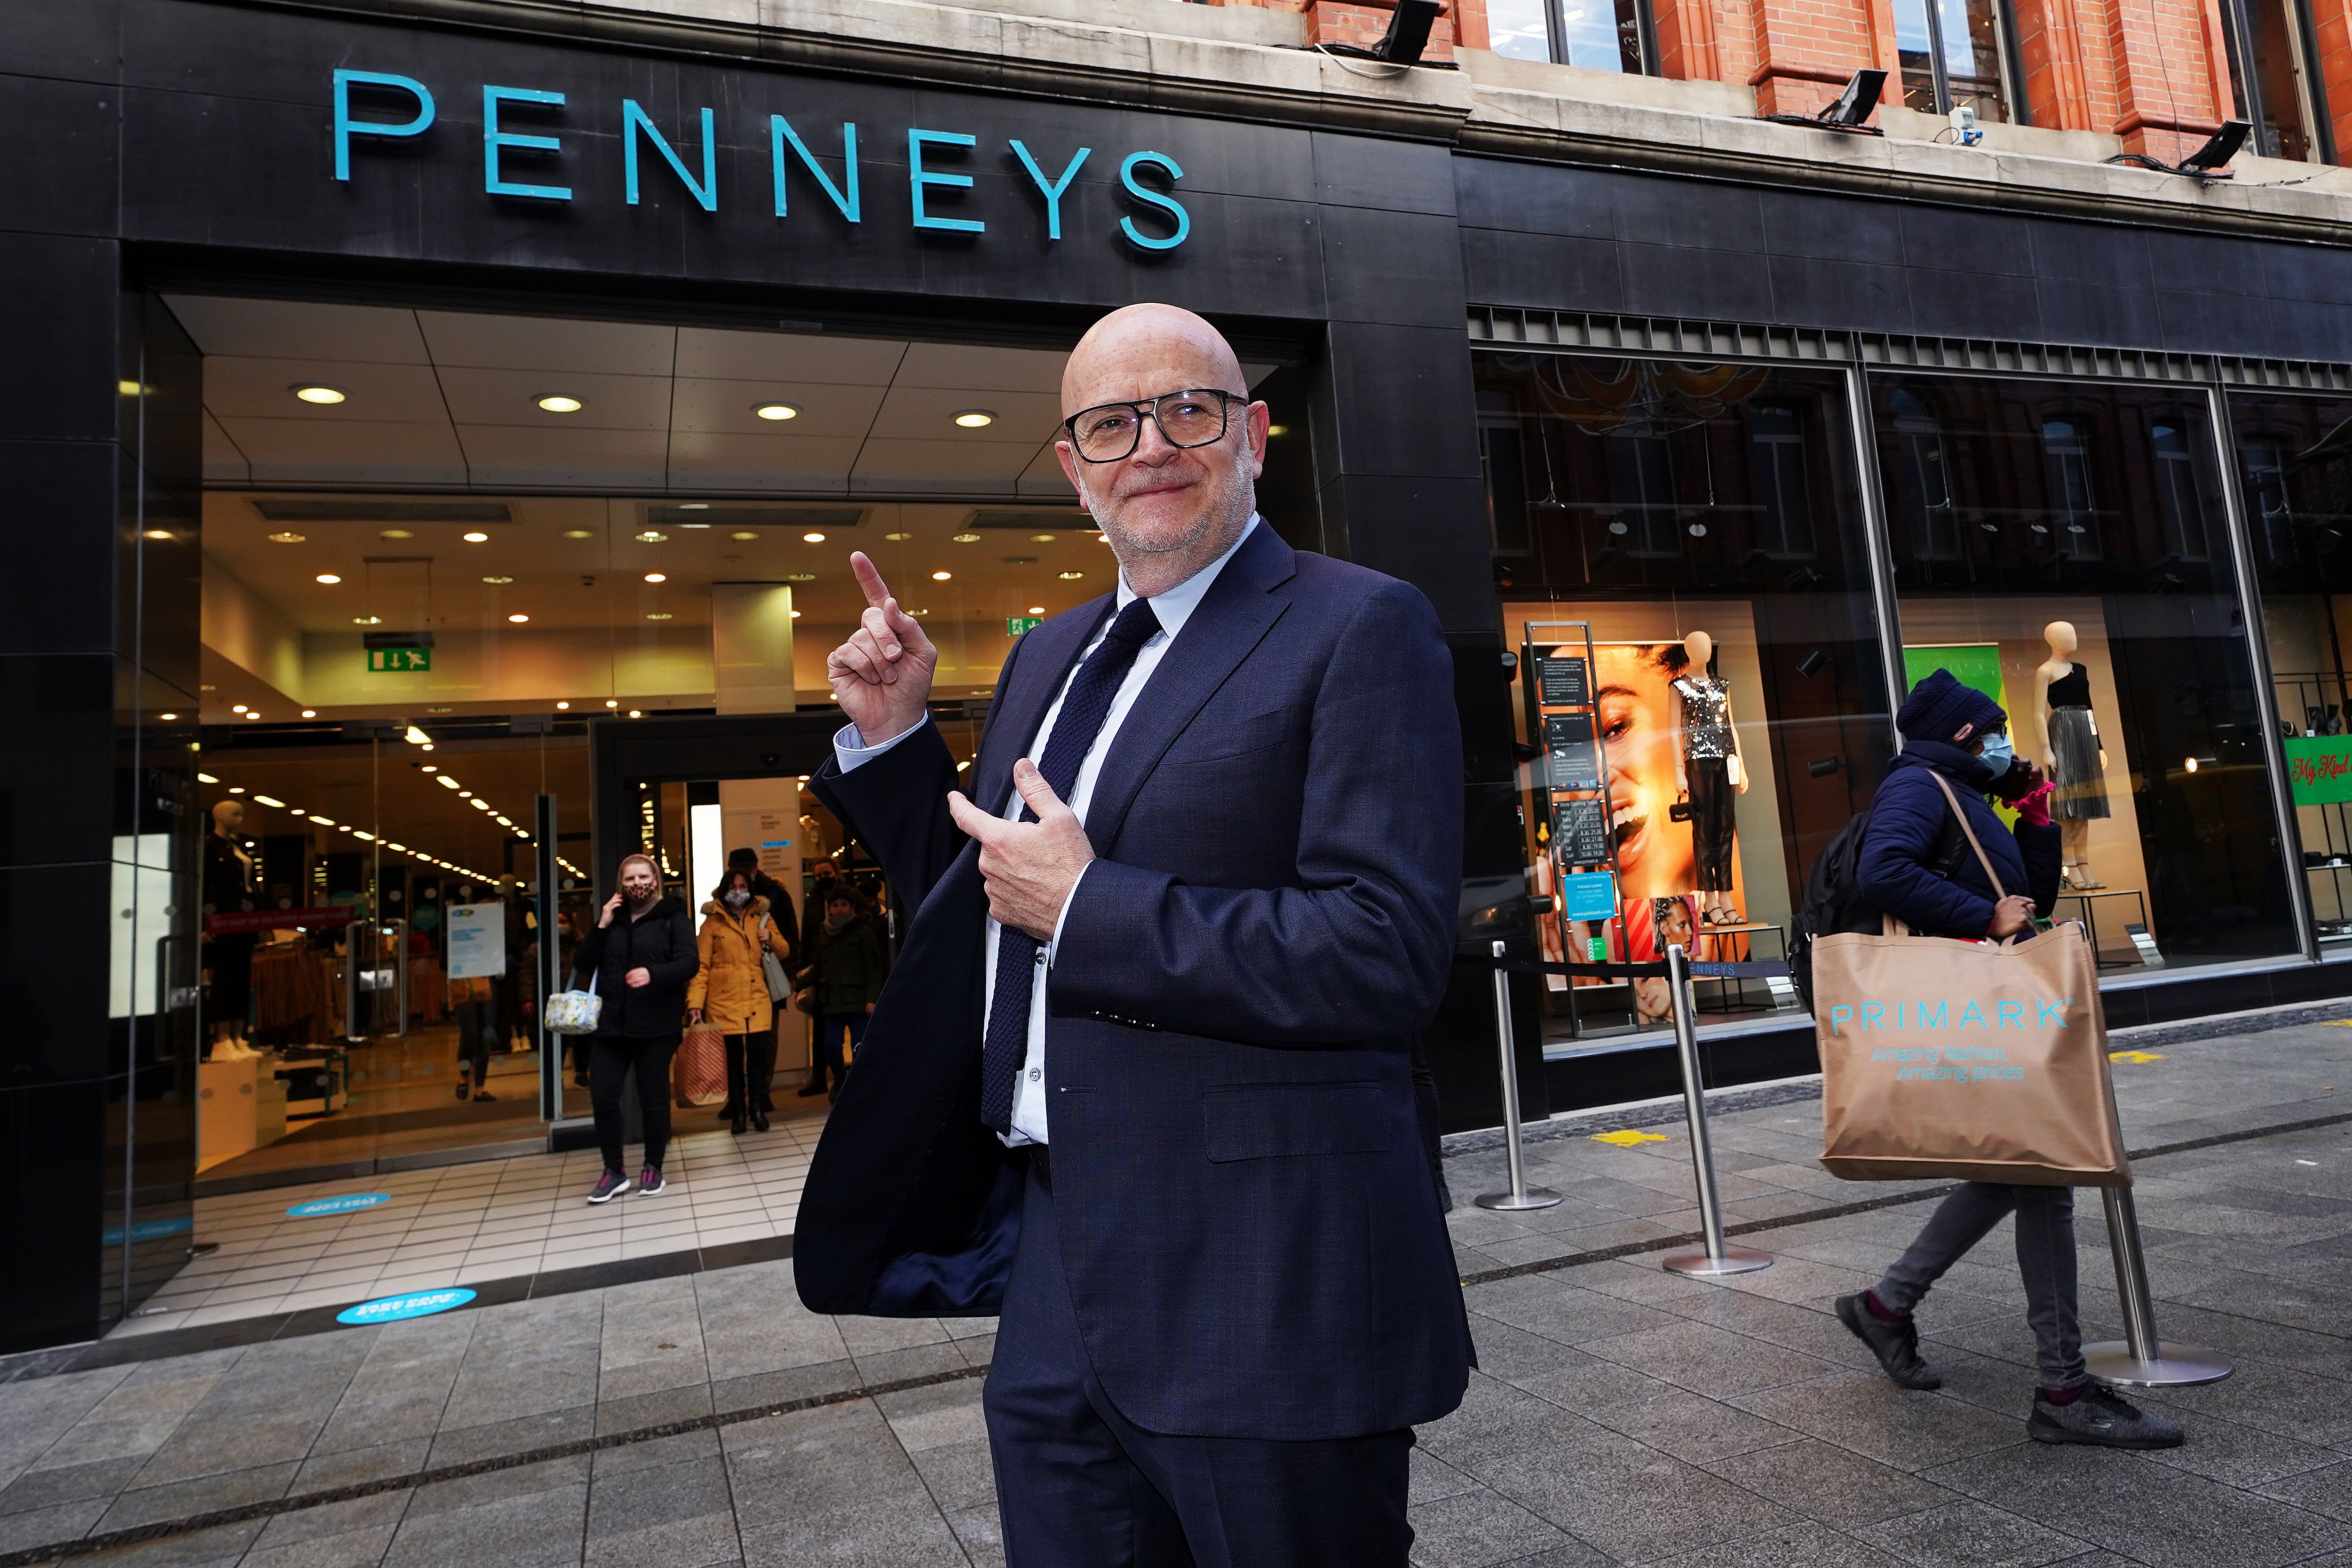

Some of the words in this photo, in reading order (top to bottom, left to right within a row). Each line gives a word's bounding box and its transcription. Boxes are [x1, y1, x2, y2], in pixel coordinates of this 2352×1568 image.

[333, 69, 1190, 249] PENNEYS
[2291, 756, 2316, 786] My
[2318, 753, 2350, 779] Kind
[1690, 962, 1735, 976] ENNEYS
[1832, 999, 2068, 1035] PRIMARK
[1870, 1046, 1940, 1064] Amazing
[1896, 1065, 1969, 1084] Amazing
[1971, 1063, 2025, 1084] prices
